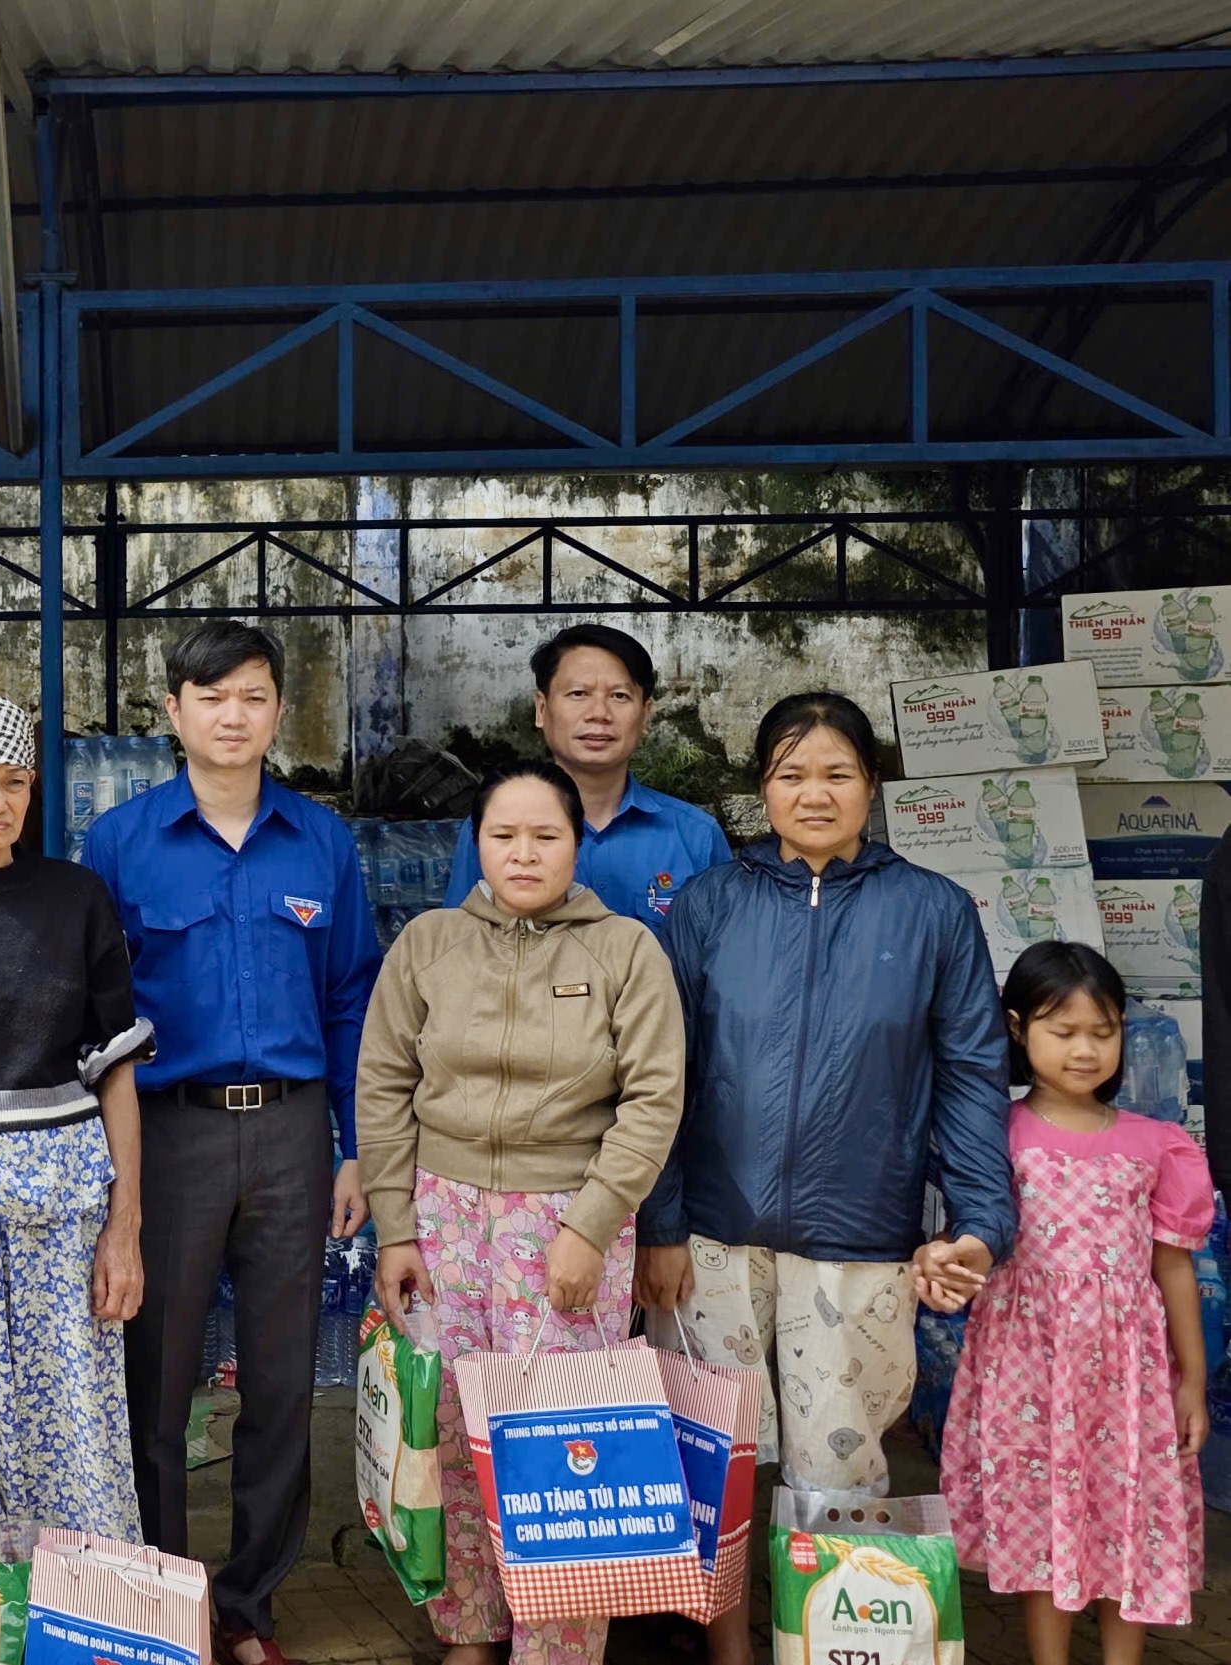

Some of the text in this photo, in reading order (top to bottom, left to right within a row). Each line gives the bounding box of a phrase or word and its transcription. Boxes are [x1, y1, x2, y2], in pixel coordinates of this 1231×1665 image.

[1068, 618, 1104, 629] THIÊN
[1092, 627, 1122, 640] 999
[903, 703, 937, 714] THIÊN
[927, 710, 956, 724] 999
[1068, 737, 1099, 748] 500 ml
[893, 803, 927, 814] THIÊN
[917, 812, 945, 825] 999
[1116, 812, 1199, 833] AQUAFINA
[1053, 843, 1083, 855] 500 ml
[1104, 912, 1133, 924] 999
[504, 1427, 531, 1440] TRUNG
[557, 1422, 581, 1436] ĐOÀN
[581, 1422, 604, 1434] TNCS
[618, 1418, 634, 1431] CHÍ
[635, 1417, 659, 1430] MINH
[681, 1432, 695, 1445] CHÍ
[502, 1482, 684, 1517] TRAO TẶNG TÚI AN SINH
[515, 1512, 676, 1543] CHO NGƯỜI DÂN VÙNG LŨ
[832, 1624, 853, 1634] Lành
[874, 1626, 896, 1636] Ngon
[42, 1622, 66, 1640] TRUNG
[89, 1636, 113, 1652] ĐOÀN
[113, 1642, 135, 1658] TNCS
[150, 1651, 165, 1665] CHÍ
